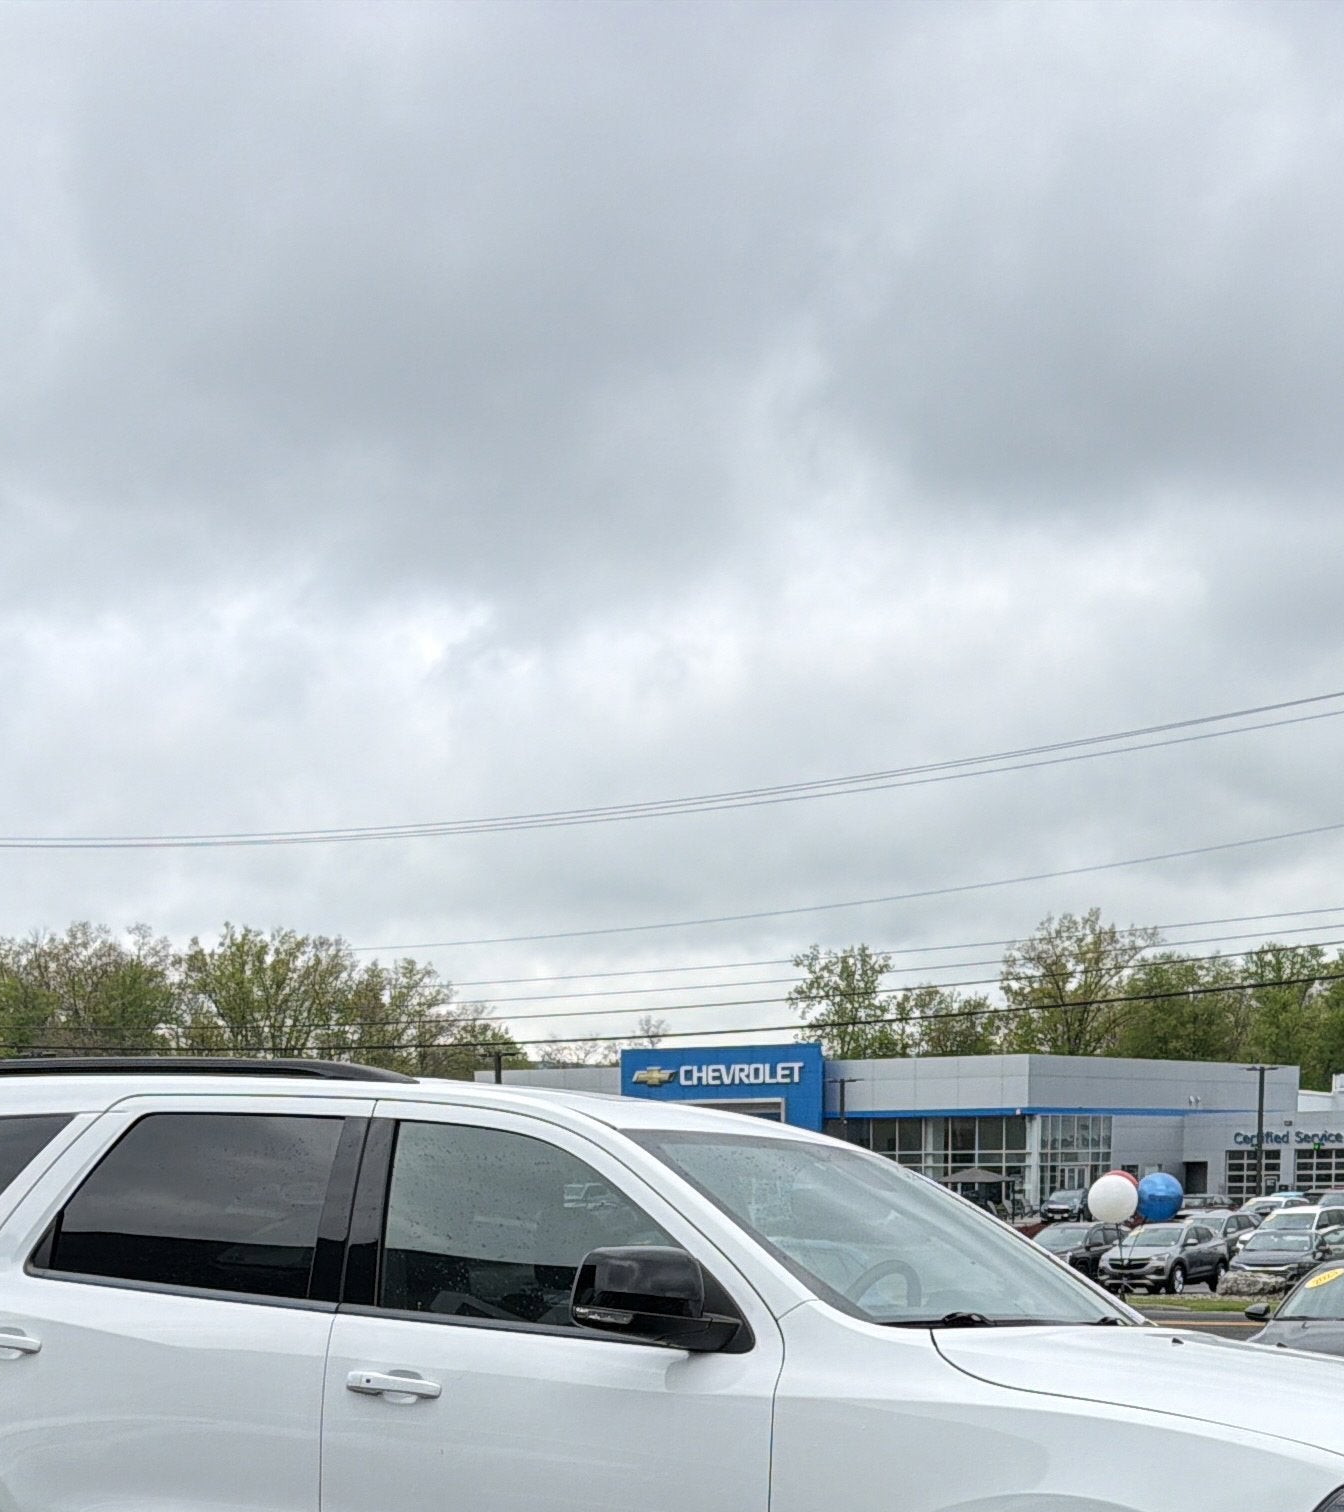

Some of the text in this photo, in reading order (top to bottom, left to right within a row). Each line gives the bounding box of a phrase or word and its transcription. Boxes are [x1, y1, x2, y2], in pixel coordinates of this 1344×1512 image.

[679, 1062, 804, 1086] CHEVROLET
[1233, 1130, 1344, 1145] Cerfied Service
